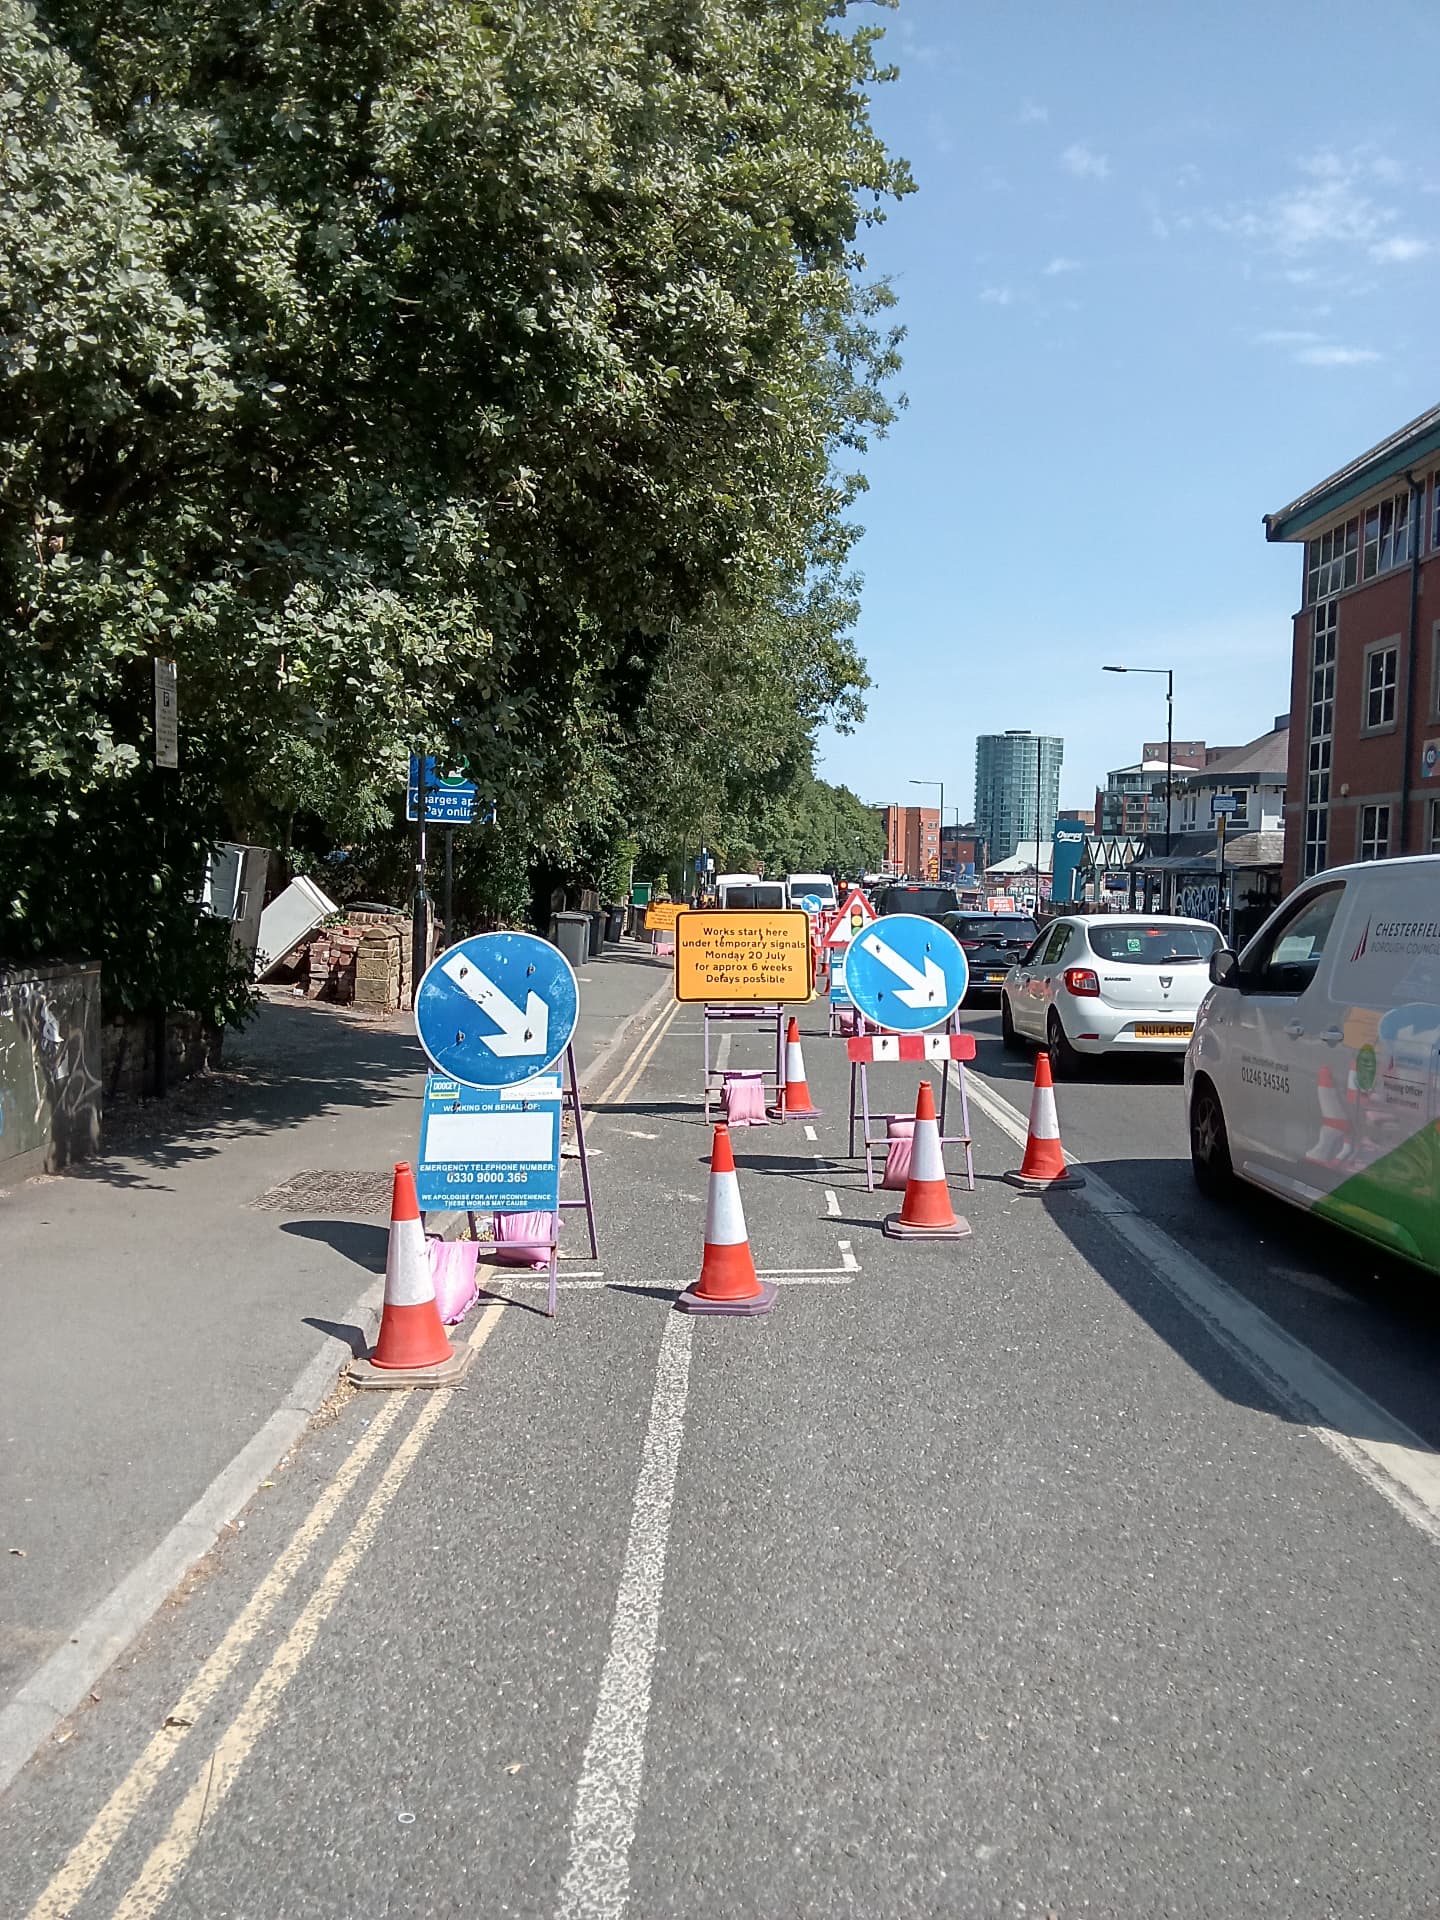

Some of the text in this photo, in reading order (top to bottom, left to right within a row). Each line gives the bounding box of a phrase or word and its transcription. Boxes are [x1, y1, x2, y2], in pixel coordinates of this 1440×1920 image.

[703, 928, 788, 937] Works start here
[1376, 923, 1440, 938] CHESTERFIEL
[682, 940, 805, 950] under temporary signals
[705, 951, 786, 961] Monday 20 July
[695, 963, 793, 973] for approx 6 weeks
[706, 975, 785, 984] Delays possible
[1241, 1066, 1290, 1093] 01246 345345
[495, 1103, 524, 1112] BEHAL
[527, 1103, 541, 1111] OF:
[420, 1164, 467, 1172] EMERGENCY
[520, 1164, 556, 1172] NUMBER:
[447, 1172, 528, 1183] 0330 9000 365
